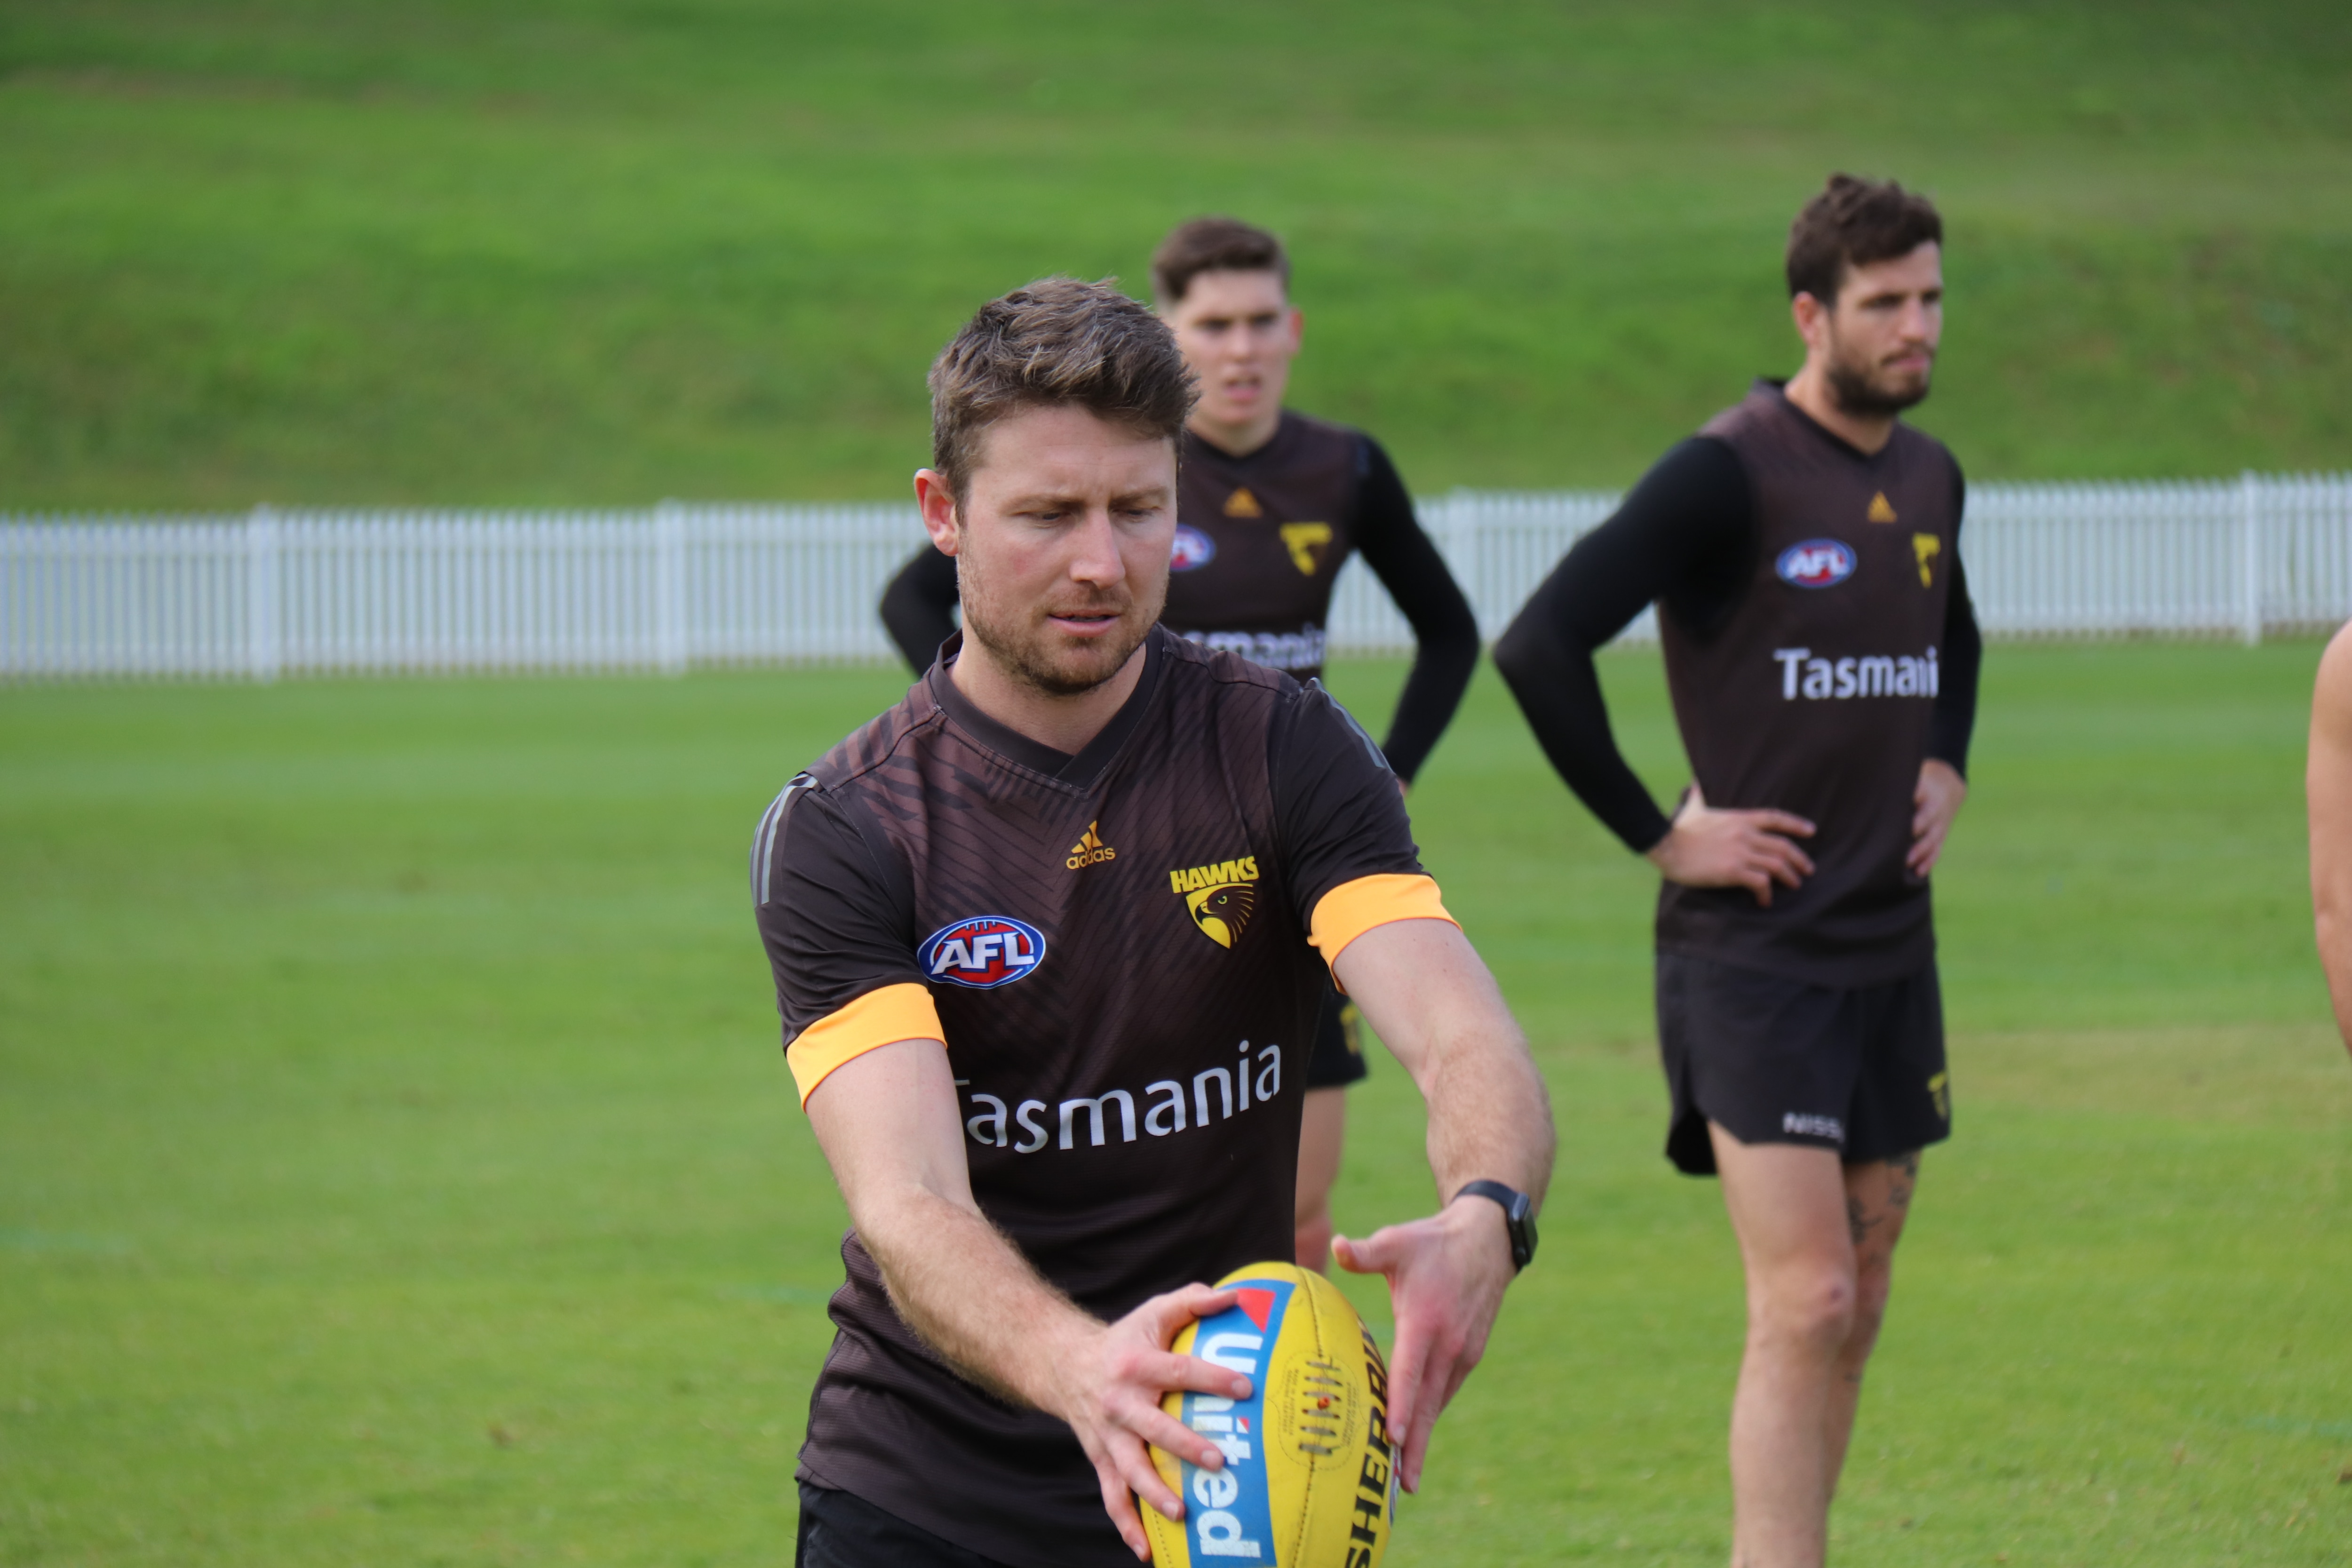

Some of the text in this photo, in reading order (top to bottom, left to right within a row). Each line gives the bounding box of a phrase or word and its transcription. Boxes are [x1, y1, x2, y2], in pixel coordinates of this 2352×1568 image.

[1788, 549, 1851, 579] AFL
[1066, 846, 1116, 870] addas
[1169, 856, 1260, 893] HAWKS
[930, 931, 1035, 975] AFL
